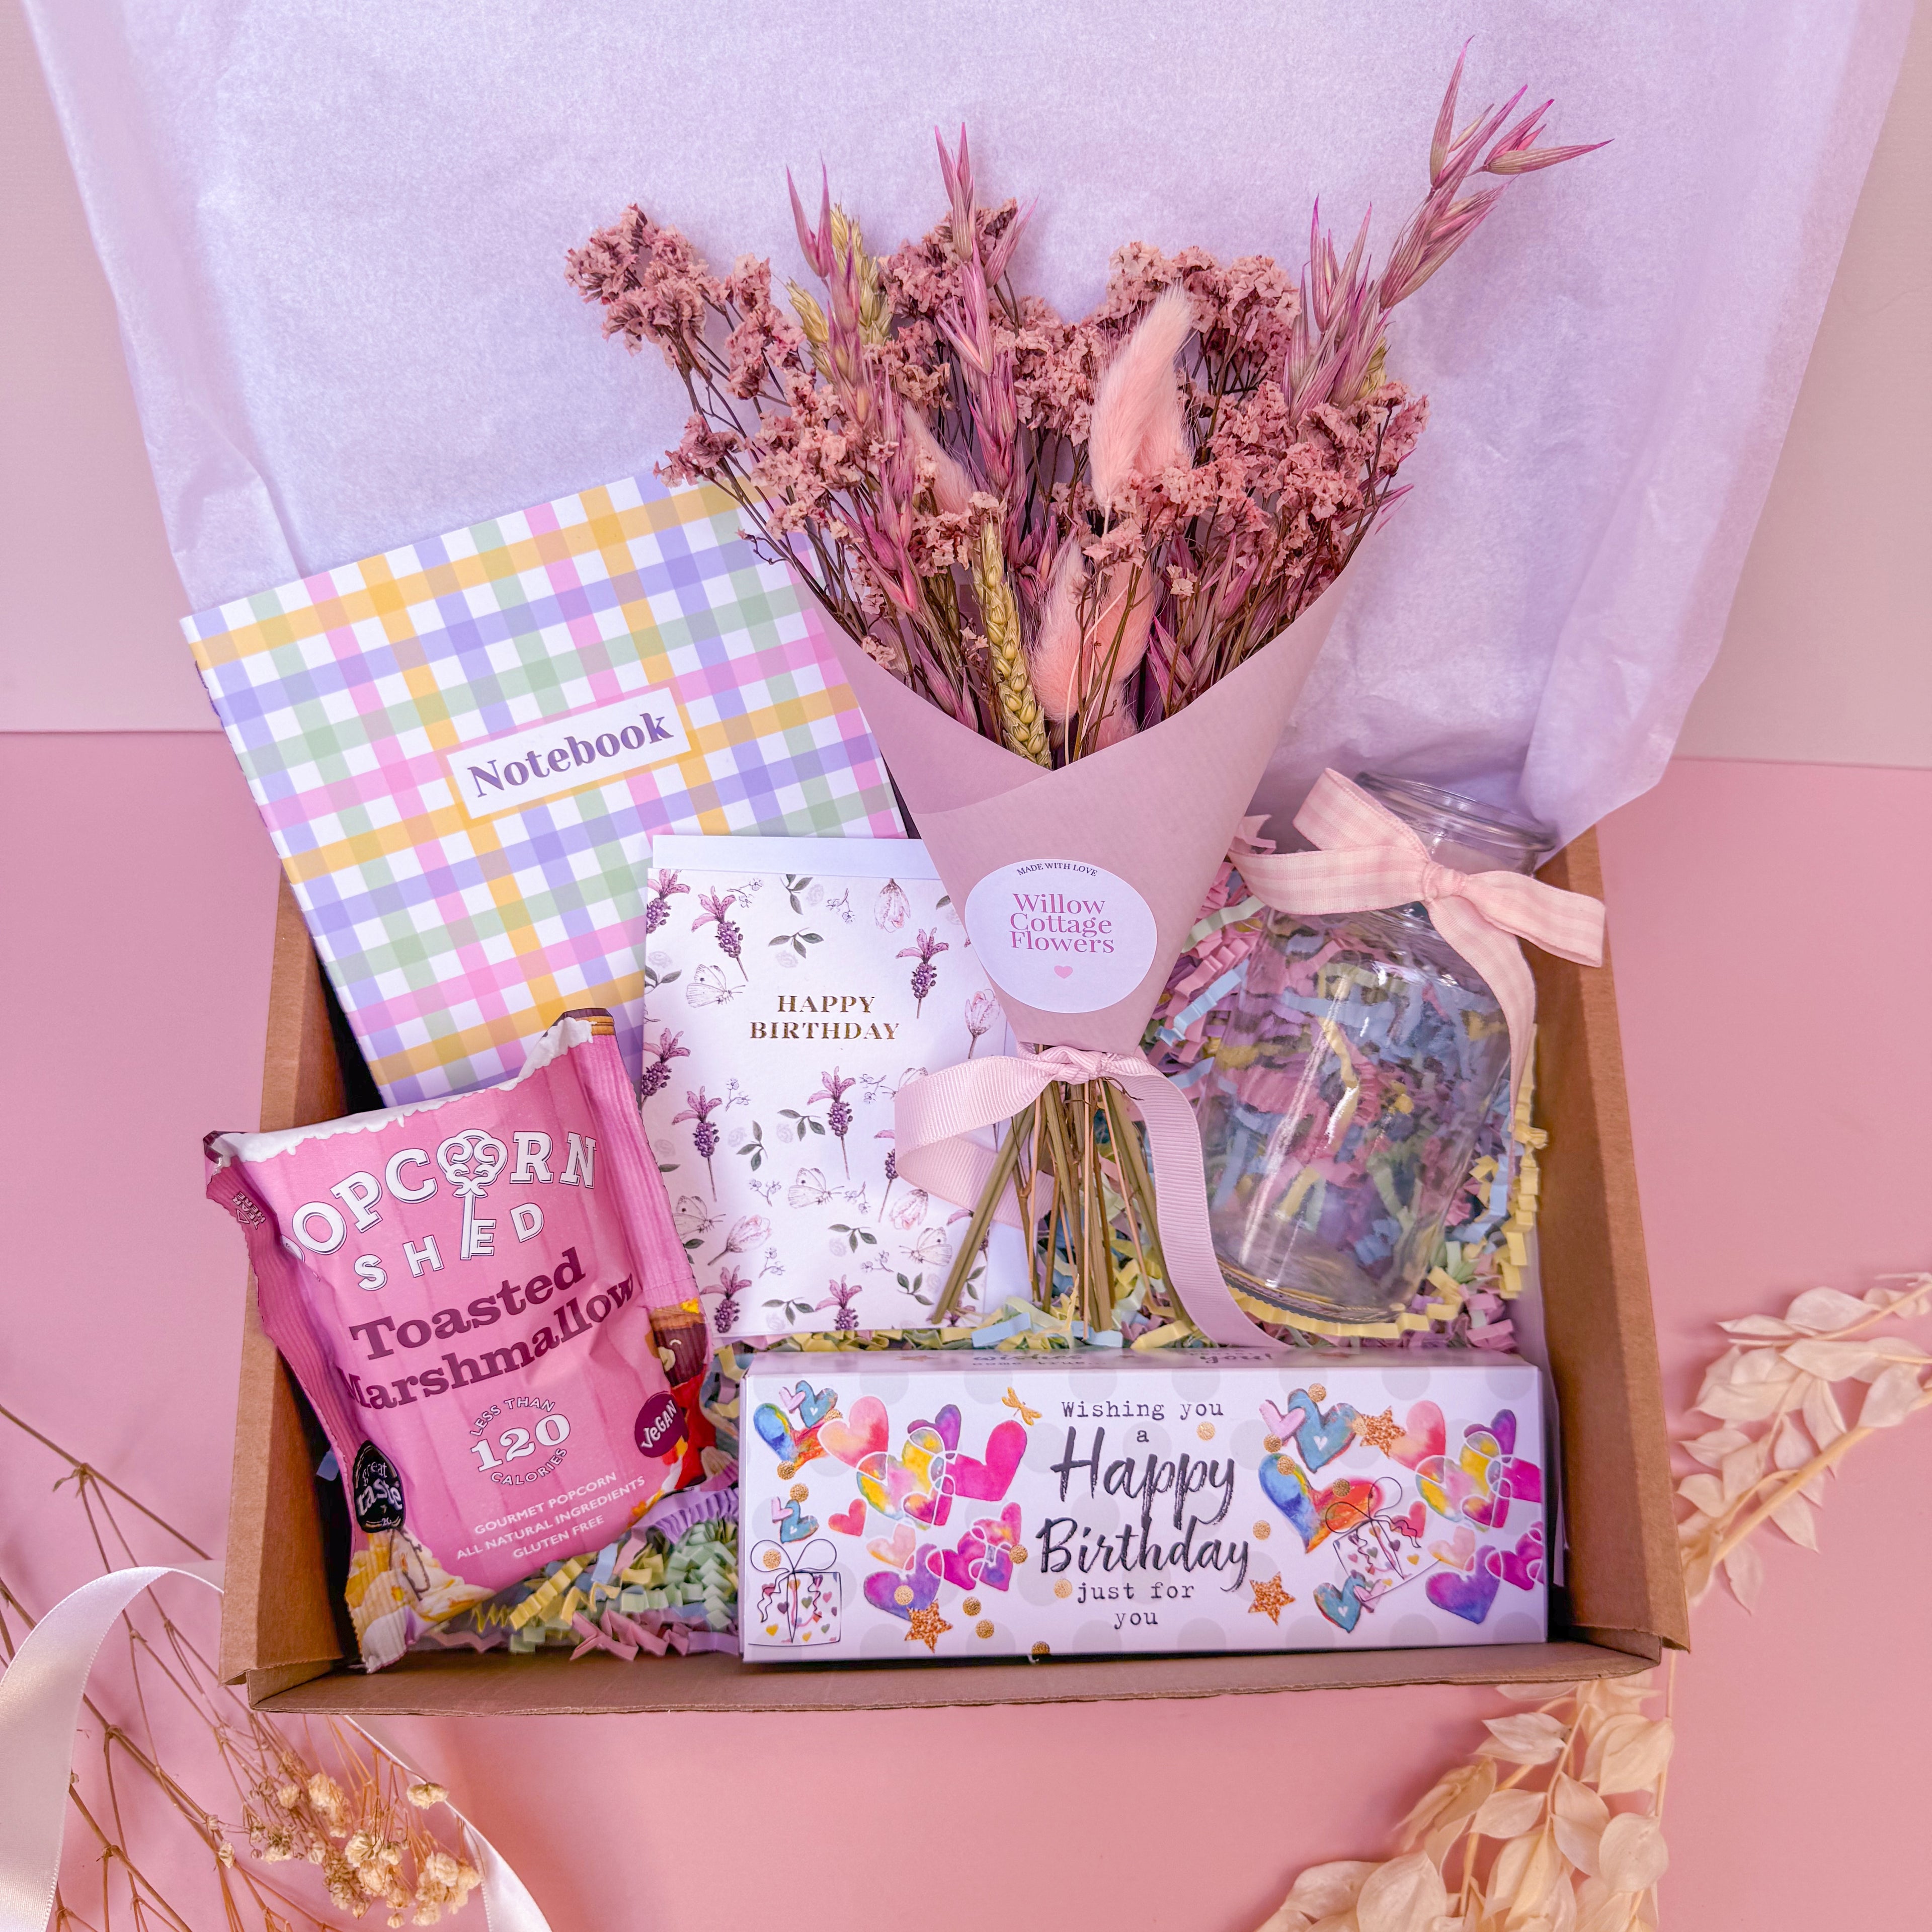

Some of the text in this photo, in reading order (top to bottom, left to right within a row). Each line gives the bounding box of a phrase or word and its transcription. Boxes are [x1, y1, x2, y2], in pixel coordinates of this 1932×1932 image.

[466, 712, 674, 797] Notebook
[1016, 863, 1043, 875] MADE
[1073, 864, 1098, 877] LOVE
[1012, 893, 1106, 914] Willow
[1009, 930, 1114, 953] Flowers
[1010, 912, 1112, 938] Cottage
[777, 995, 875, 1013] HAPPY
[750, 1021, 900, 1040] BIRTHDAY
[232, 1196, 260, 1230] TEAR
[236, 1190, 266, 1224] HERE
[354, 1202, 545, 1291] SHED
[348, 1246, 586, 1360] Toasted
[469, 1397, 555, 1437] LESS THAN
[1061, 1400, 1224, 1421] Wishing you
[470, 1413, 571, 1472] 120
[1136, 1429, 1150, 1443] a
[491, 1448, 568, 1485] CALORIES
[1050, 1425, 1235, 1531] Happy
[457, 1475, 646, 1560] ALL NATURAL INGREDIENTS
[474, 1472, 617, 1535] GOURMET POPCORN
[513, 1514, 605, 1559] GLUTEN FREE
[1035, 1513, 1249, 1593] Birthday
[1077, 1581, 1195, 1604] just for
[1114, 1612, 1159, 1630] you
